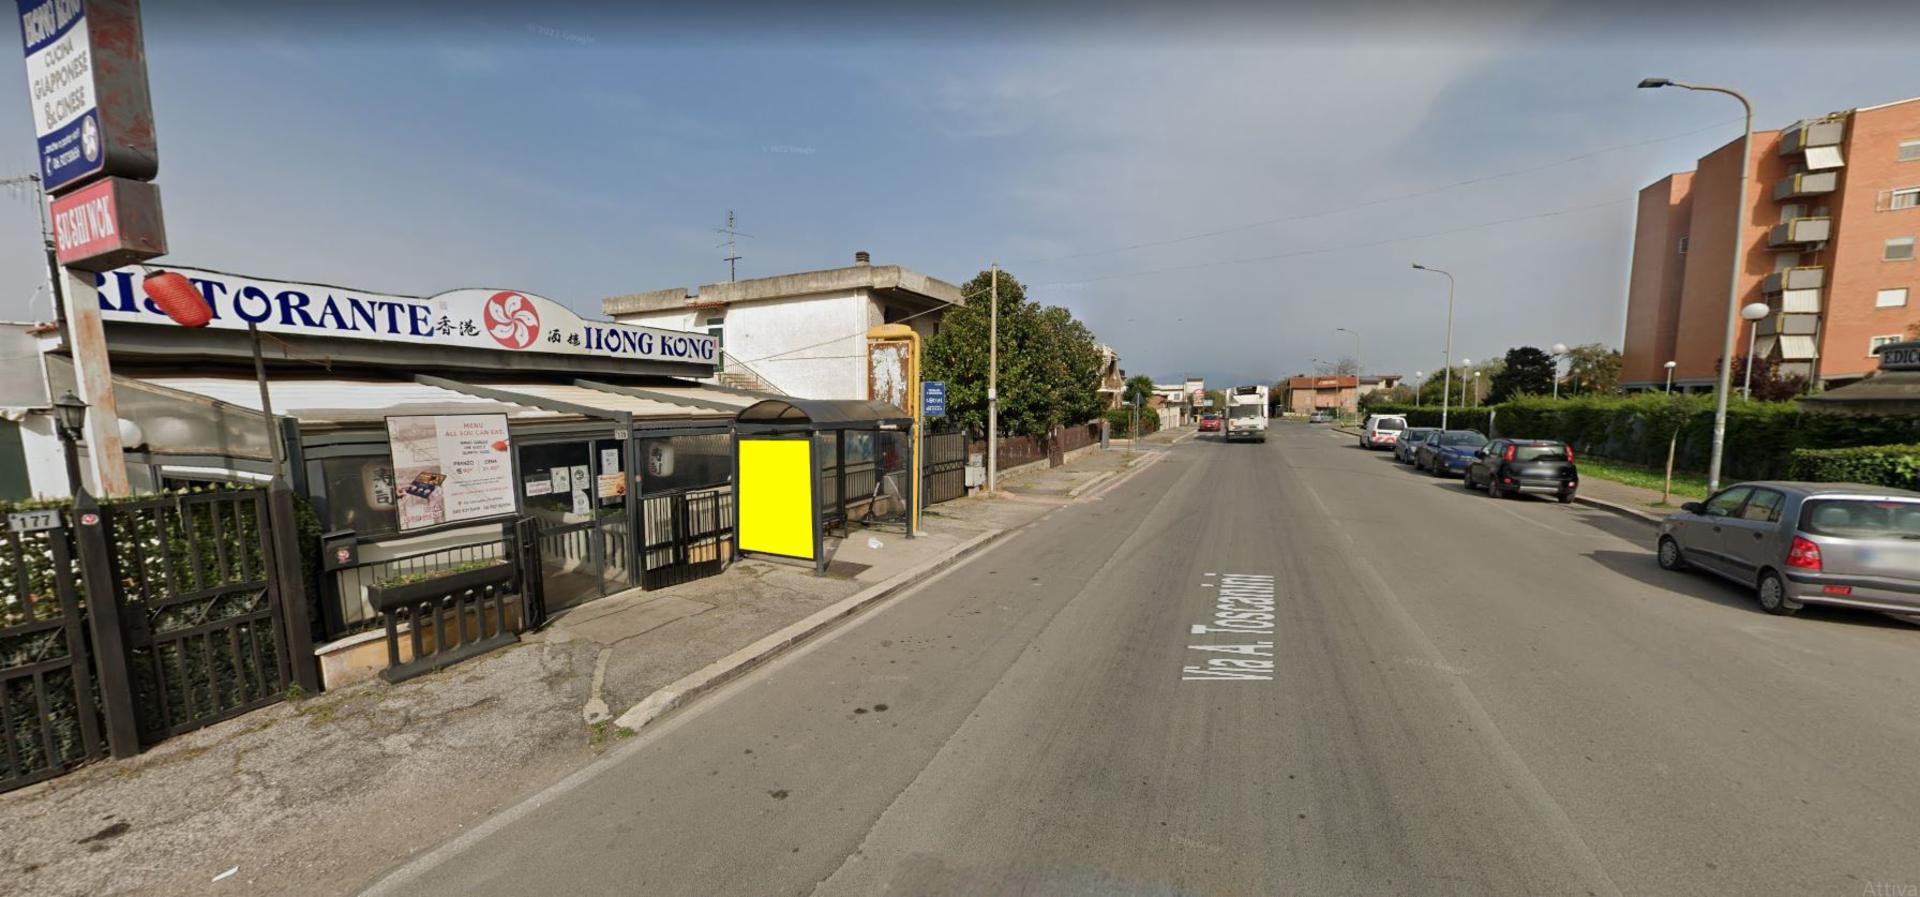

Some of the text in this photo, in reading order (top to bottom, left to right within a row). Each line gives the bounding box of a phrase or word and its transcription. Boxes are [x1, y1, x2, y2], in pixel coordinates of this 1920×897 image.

[23, 0, 57, 47] HONG
[44, 36, 74, 68] CUCINA
[33, 50, 88, 100] GIAPPONESE
[56, 195, 115, 252] SUSHI WOK
[95, 271, 434, 337] ITORANTE
[435, 315, 481, 337] 香港
[583, 326, 713, 361] HONG KONG
[1884, 348, 1920, 364] EDIC
[19, 514, 51, 529] 177
